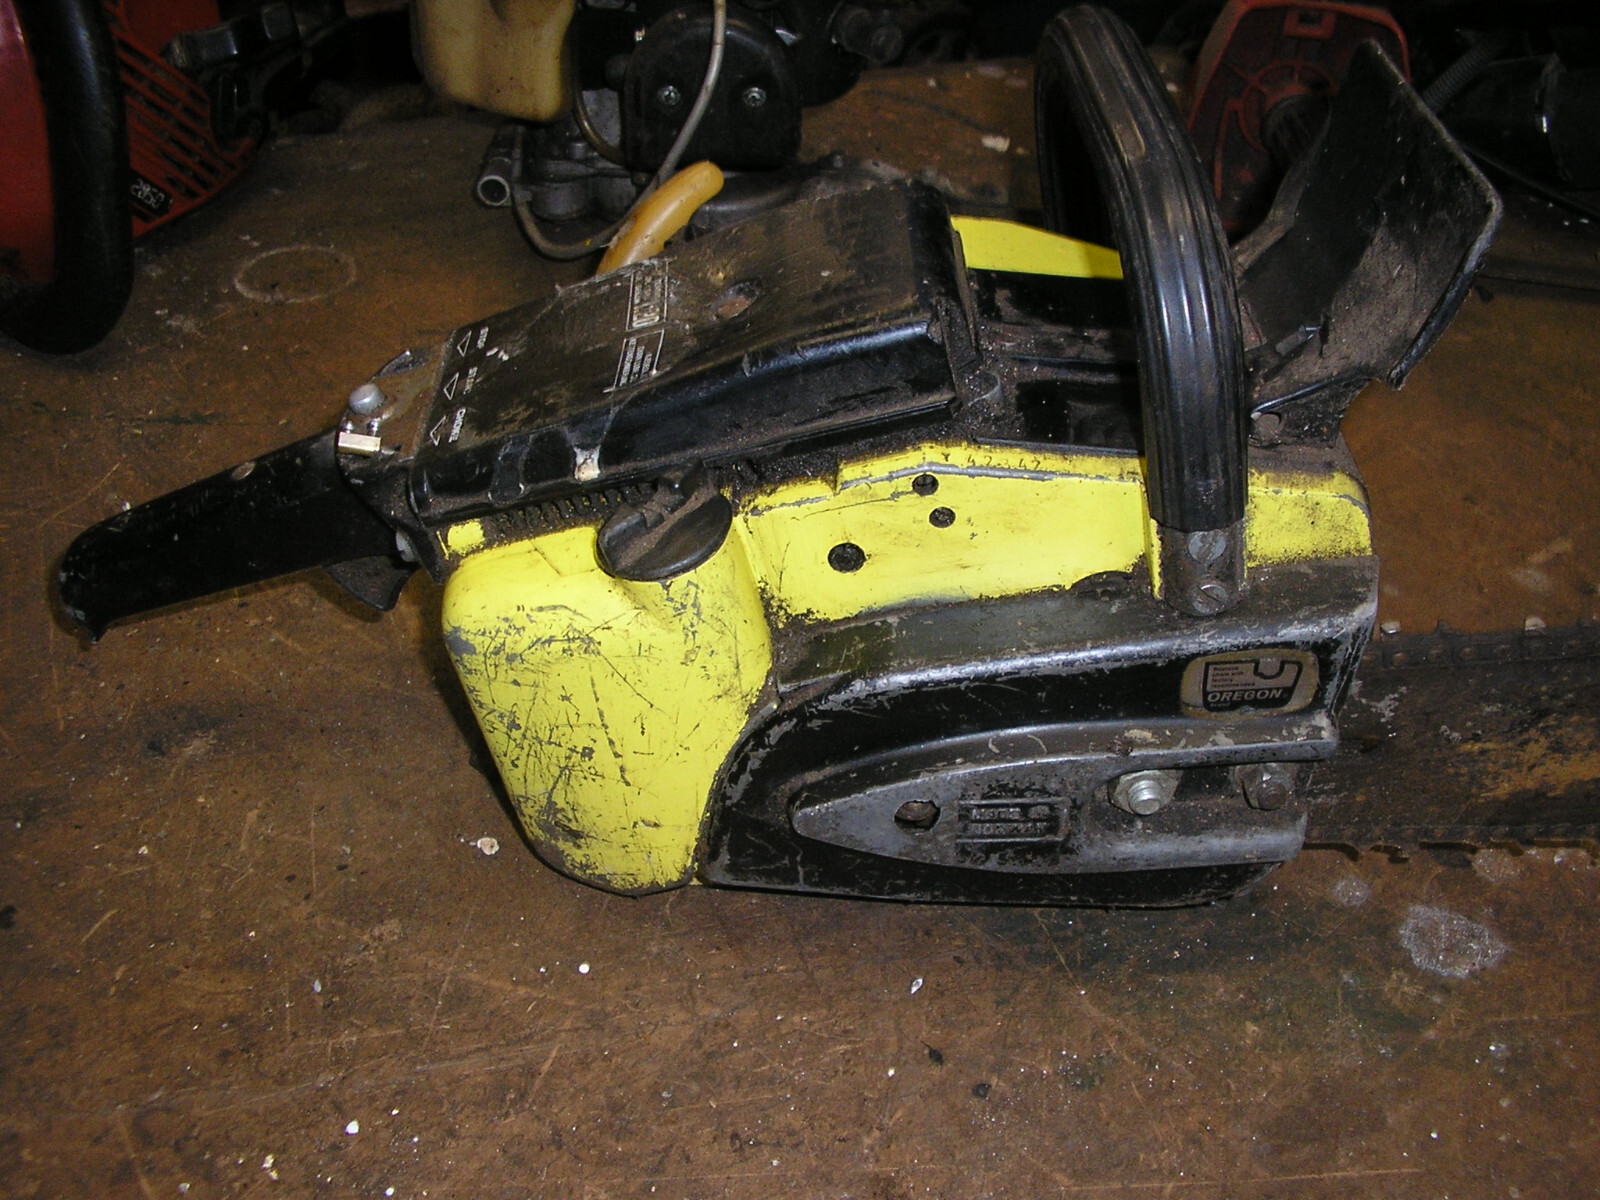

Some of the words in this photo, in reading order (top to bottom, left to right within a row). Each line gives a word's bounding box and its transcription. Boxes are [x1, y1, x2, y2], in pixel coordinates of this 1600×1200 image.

[477, 326, 489, 349] STOP
[448, 407, 466, 443] CHOKE
[1207, 688, 1283, 702] OREGON
